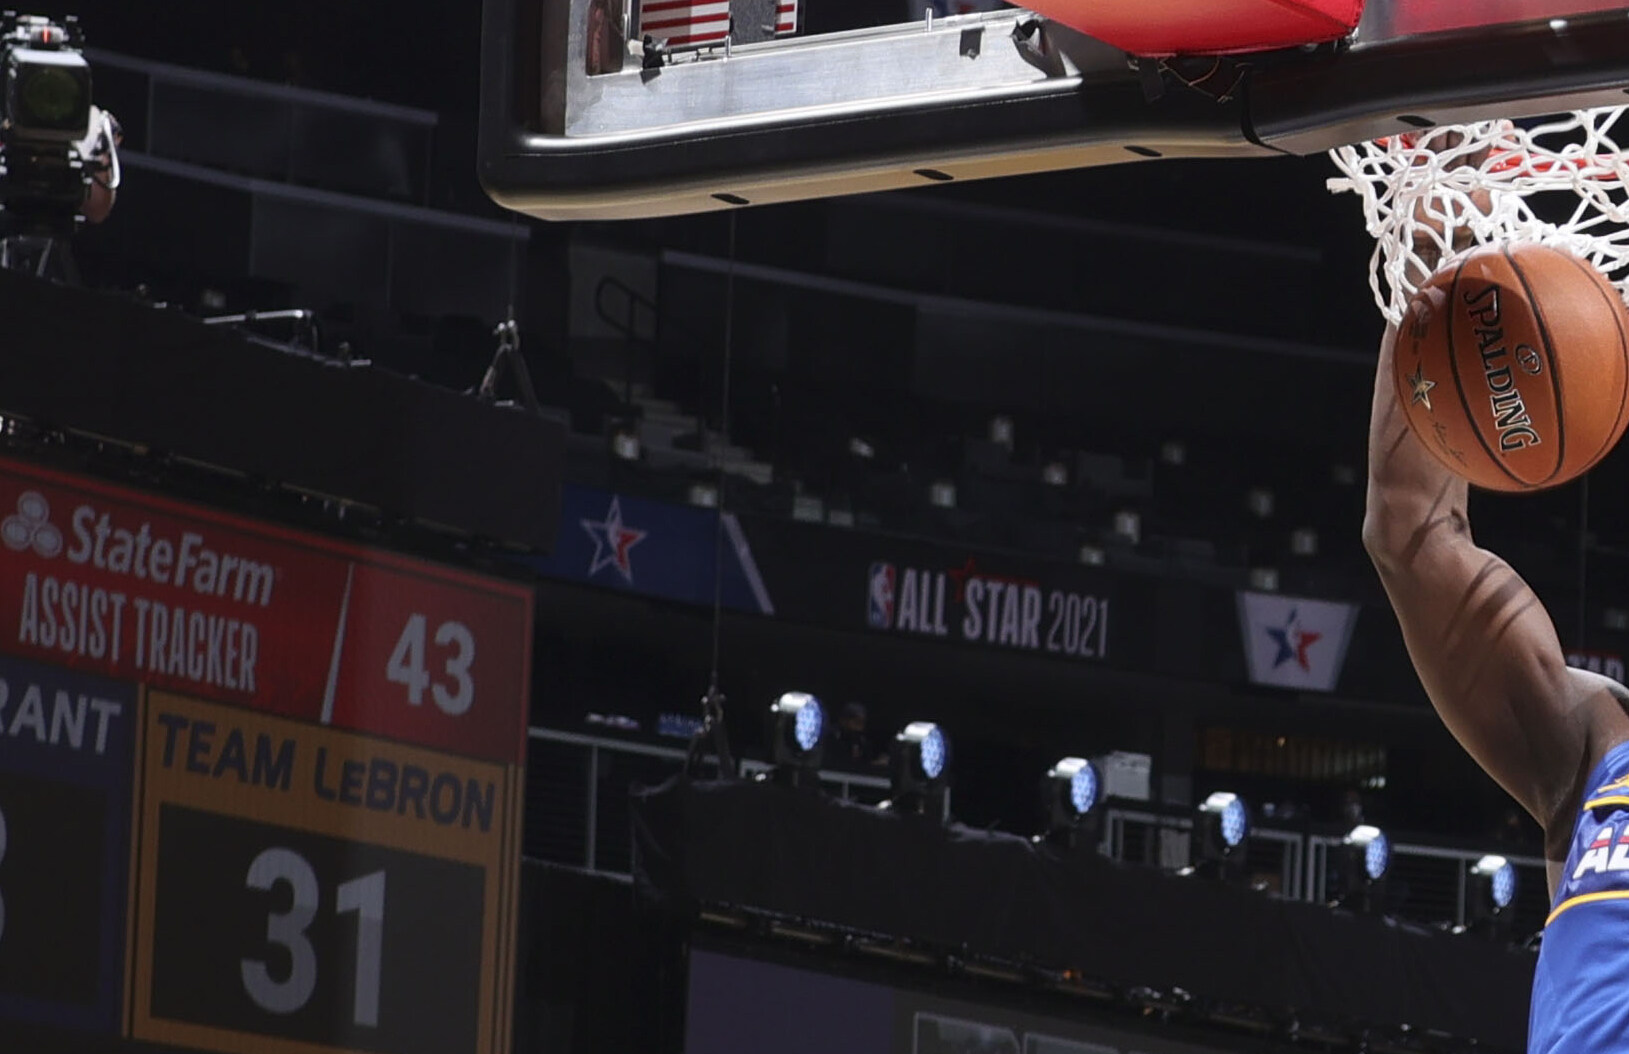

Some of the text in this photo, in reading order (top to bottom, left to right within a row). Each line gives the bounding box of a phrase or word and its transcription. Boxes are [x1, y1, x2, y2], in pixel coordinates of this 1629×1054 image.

[1463, 284, 1542, 453] SPALDING
[20, 573, 259, 693] ASSIST TRACKER
[386, 614, 476, 716] 43
[897, 567, 1110, 659] ALL STAR 2021
[157, 713, 296, 792] TEAM
[240, 846, 386, 1028] 31
